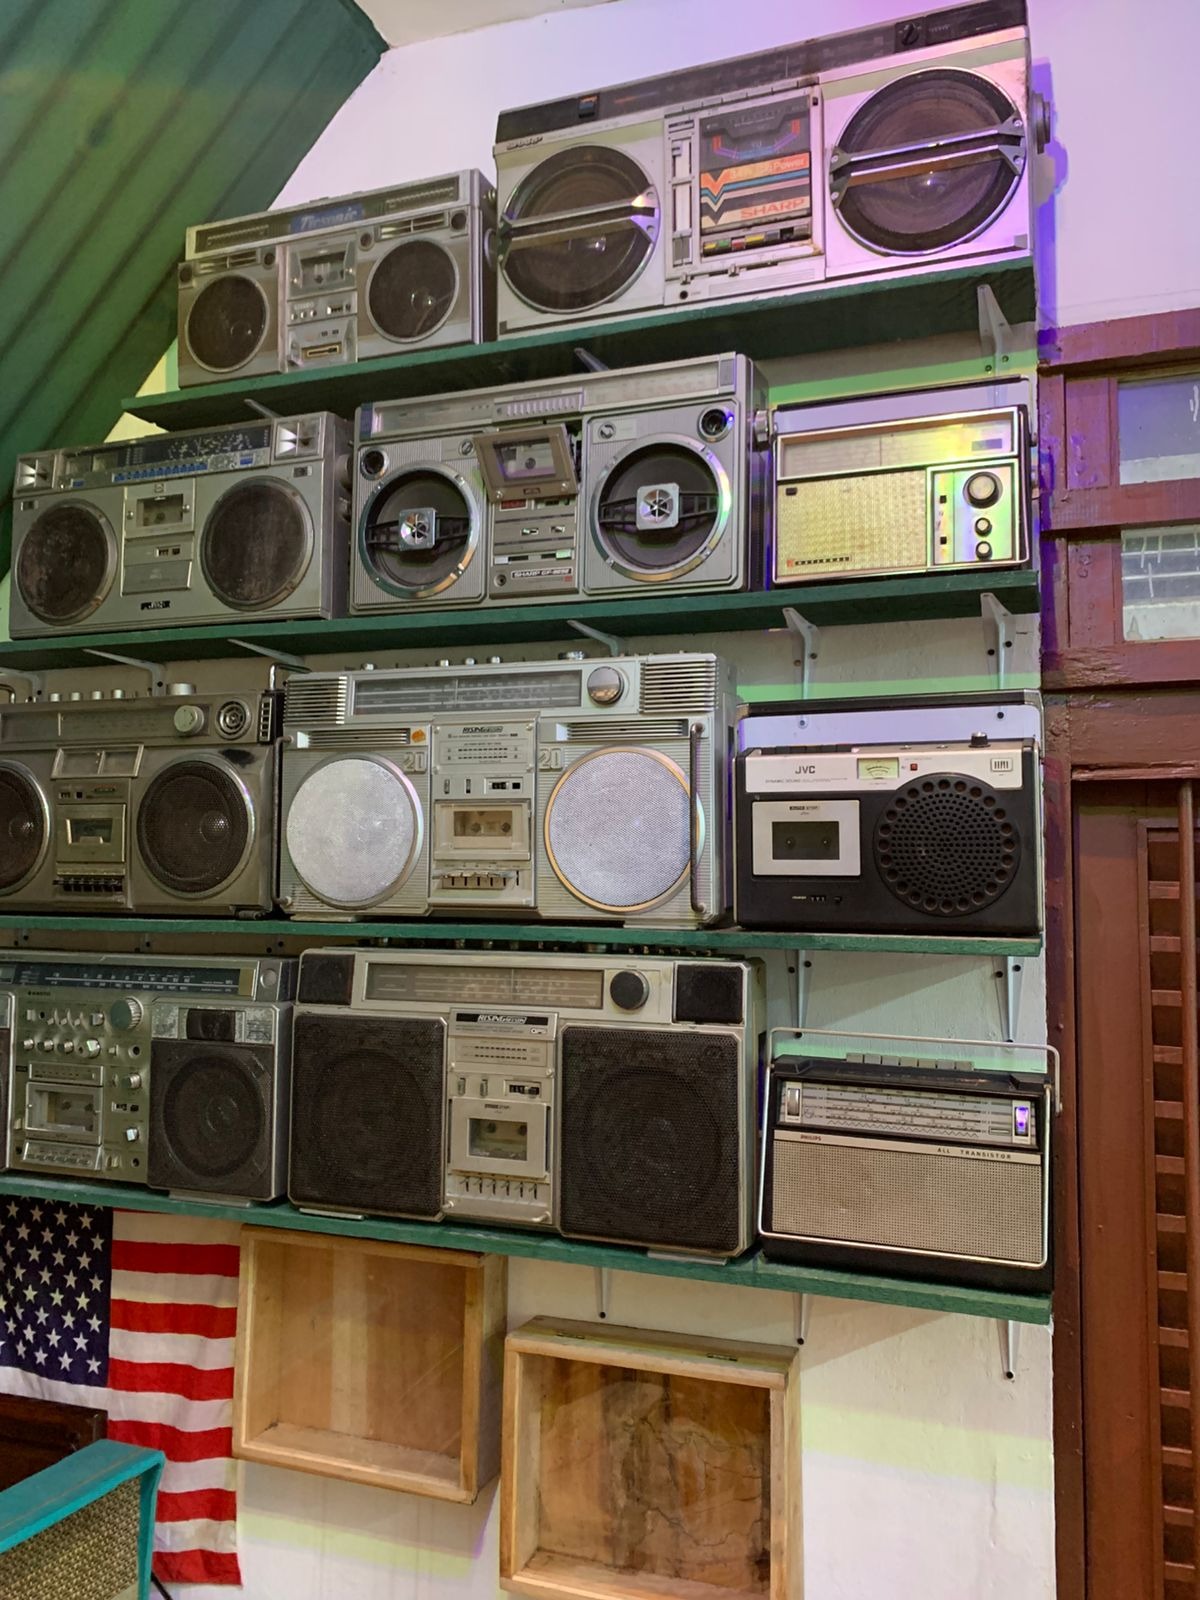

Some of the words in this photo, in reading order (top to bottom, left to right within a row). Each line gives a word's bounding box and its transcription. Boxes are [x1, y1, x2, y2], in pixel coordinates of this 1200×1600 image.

[740, 198, 805, 218] SHARP
[514, 569, 540, 577] SHARP
[403, 751, 426, 774] 20
[539, 748, 563, 771] 20
[795, 765, 816, 774] JVC
[960, 1150, 1011, 1159] TRANSISTOR
